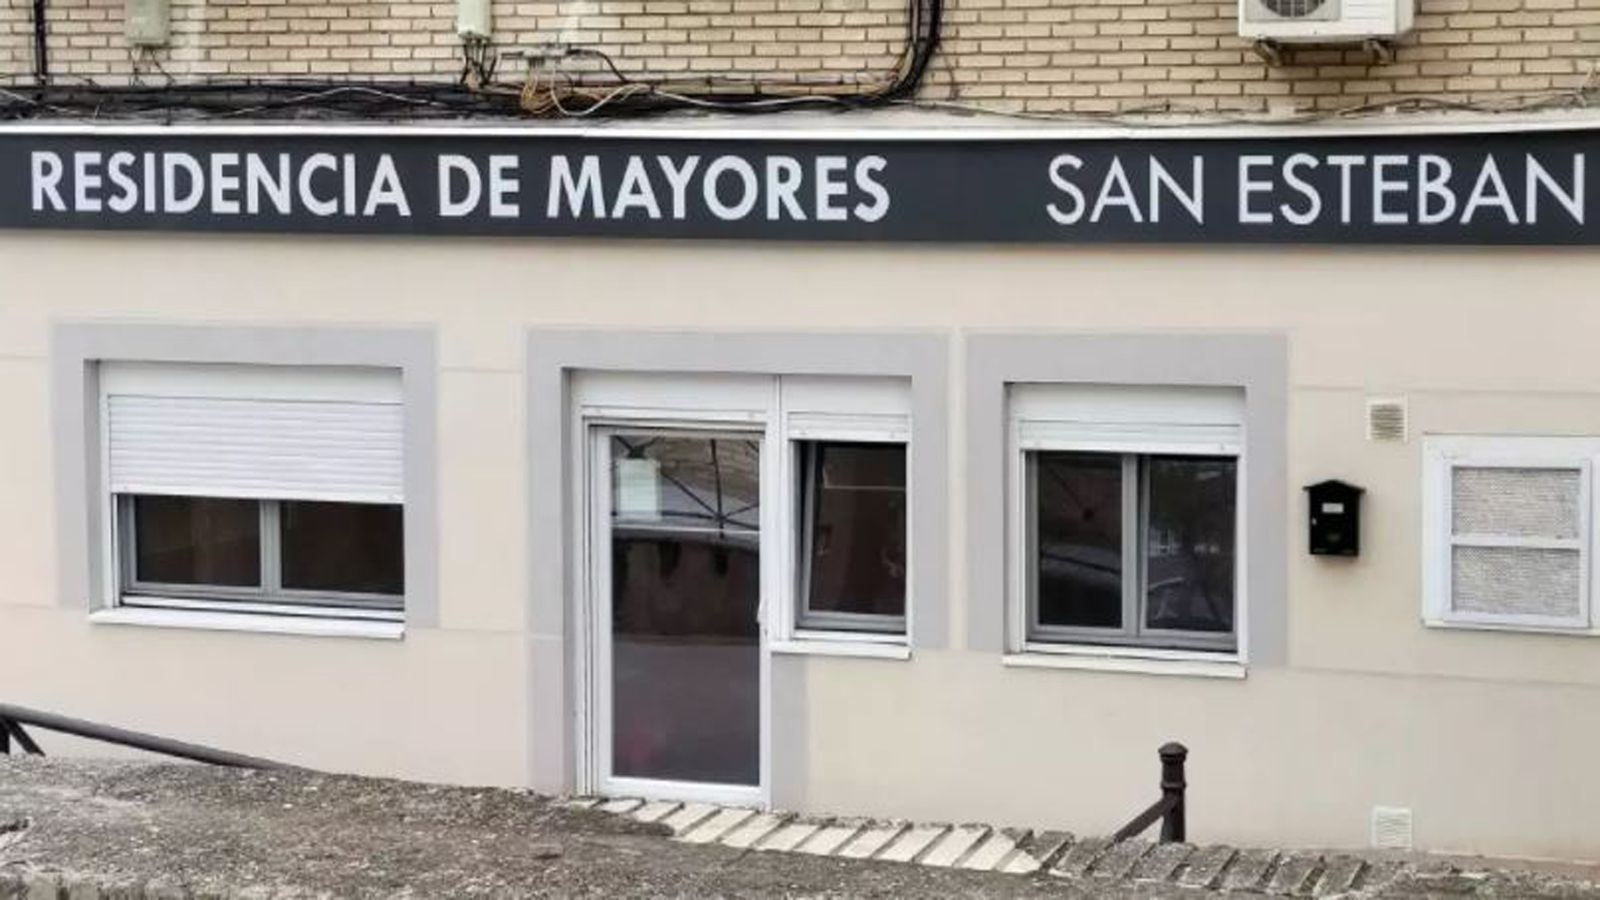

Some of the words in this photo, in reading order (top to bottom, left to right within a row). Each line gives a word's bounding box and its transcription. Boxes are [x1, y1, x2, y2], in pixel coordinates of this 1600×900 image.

[31, 151, 411, 217] RESIDENCIA
[438, 155, 520, 219] DE
[547, 154, 890, 222] MAYORES
[1046, 154, 1203, 225] SAN
[1239, 153, 1584, 225] ESTEBAN
